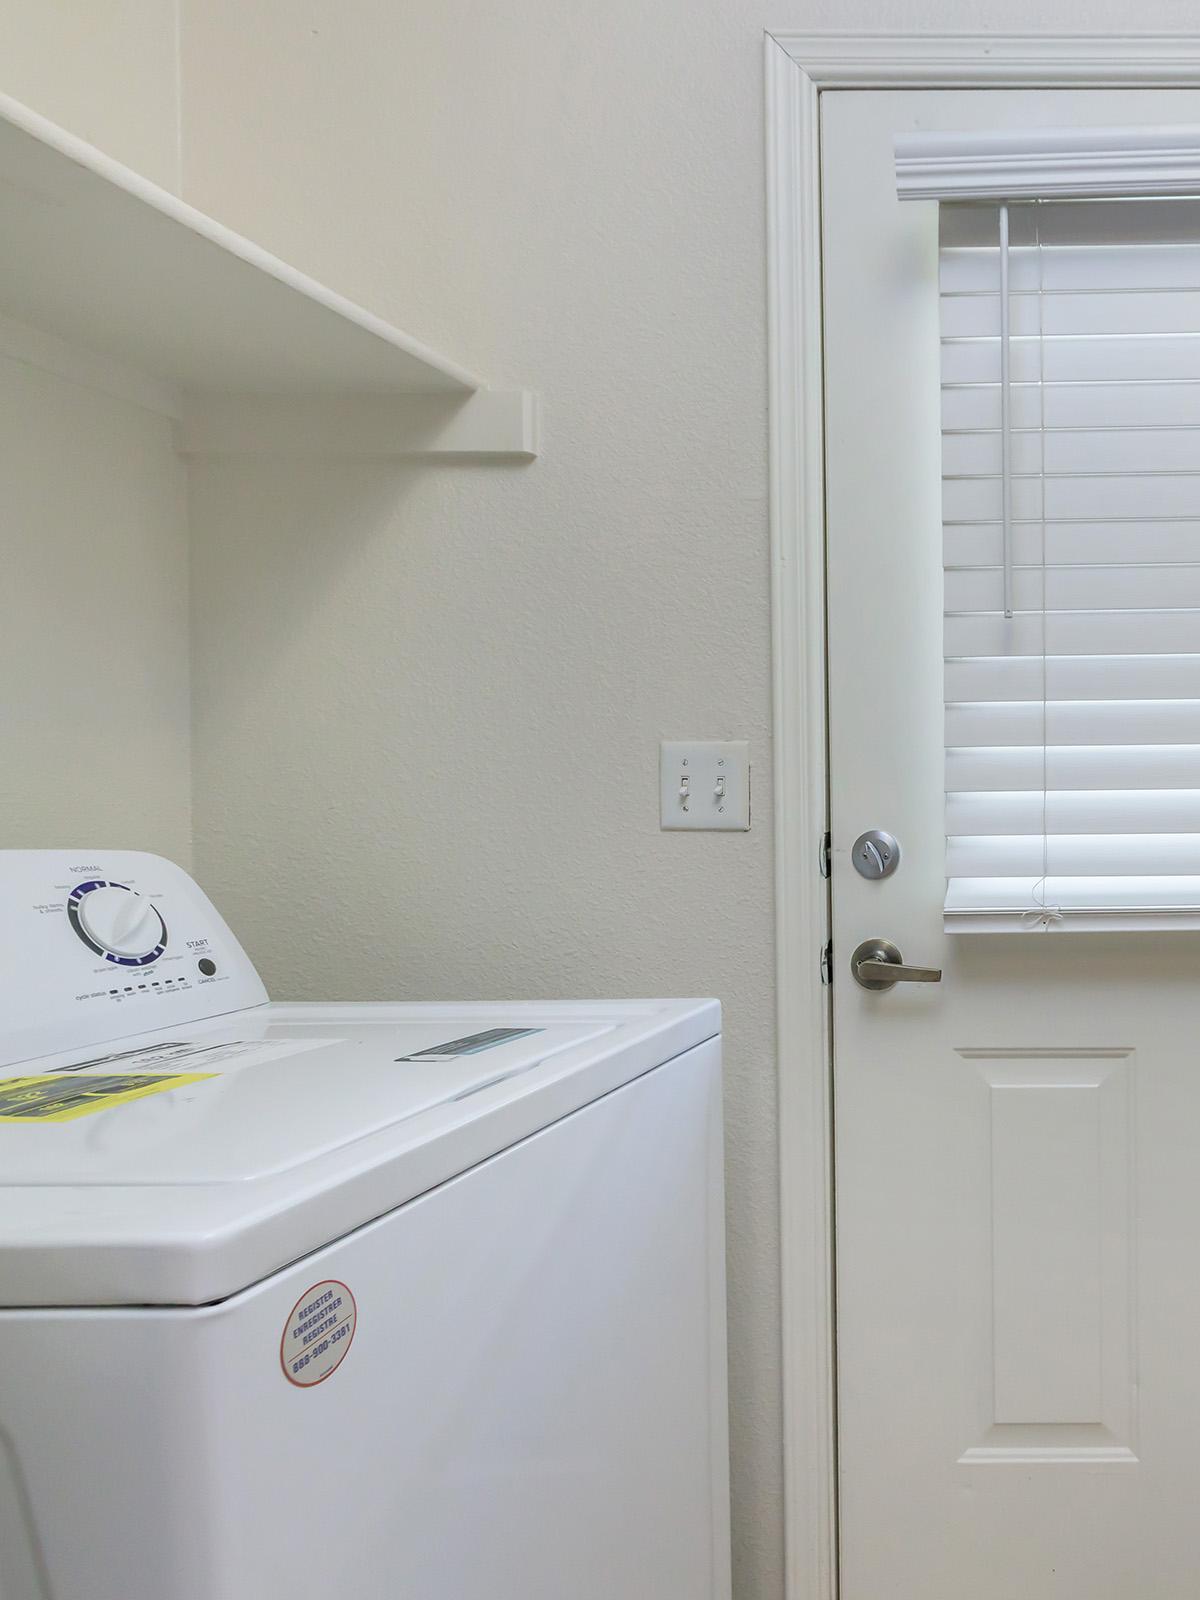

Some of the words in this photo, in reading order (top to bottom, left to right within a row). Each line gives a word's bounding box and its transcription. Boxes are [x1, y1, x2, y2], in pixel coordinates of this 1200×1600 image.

[69, 865, 104, 873] NORMAL
[186, 939, 209, 948] START
[198, 977, 216, 985] CANCEL
[298, 1290, 334, 1321] REGISTER
[293, 1297, 343, 1339] ENREGISTRER
[302, 1314, 338, 1346] REGISTRE
